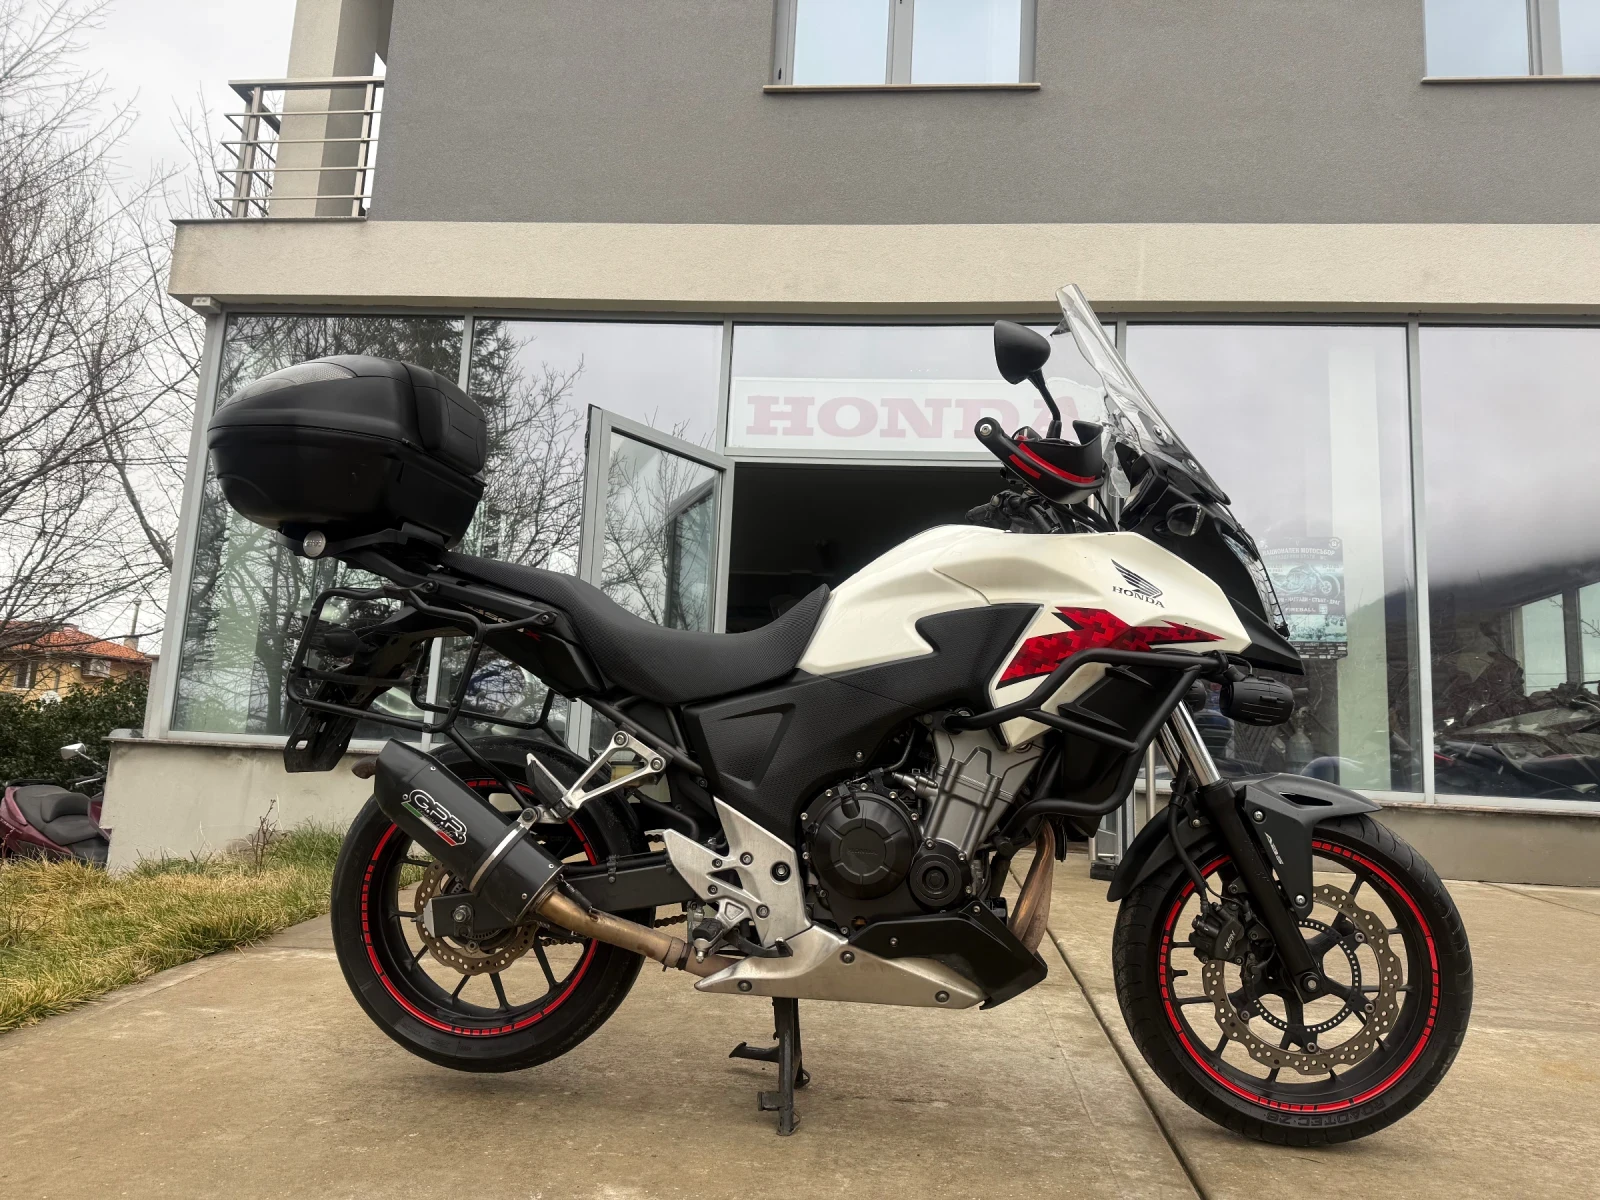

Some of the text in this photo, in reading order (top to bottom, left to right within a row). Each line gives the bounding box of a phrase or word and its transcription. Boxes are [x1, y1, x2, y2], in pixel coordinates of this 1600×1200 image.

[746, 395, 1080, 440] HONDA
[1112, 585, 1165, 608] HONDA
[1298, 1098, 1386, 1127] ROADTEC
